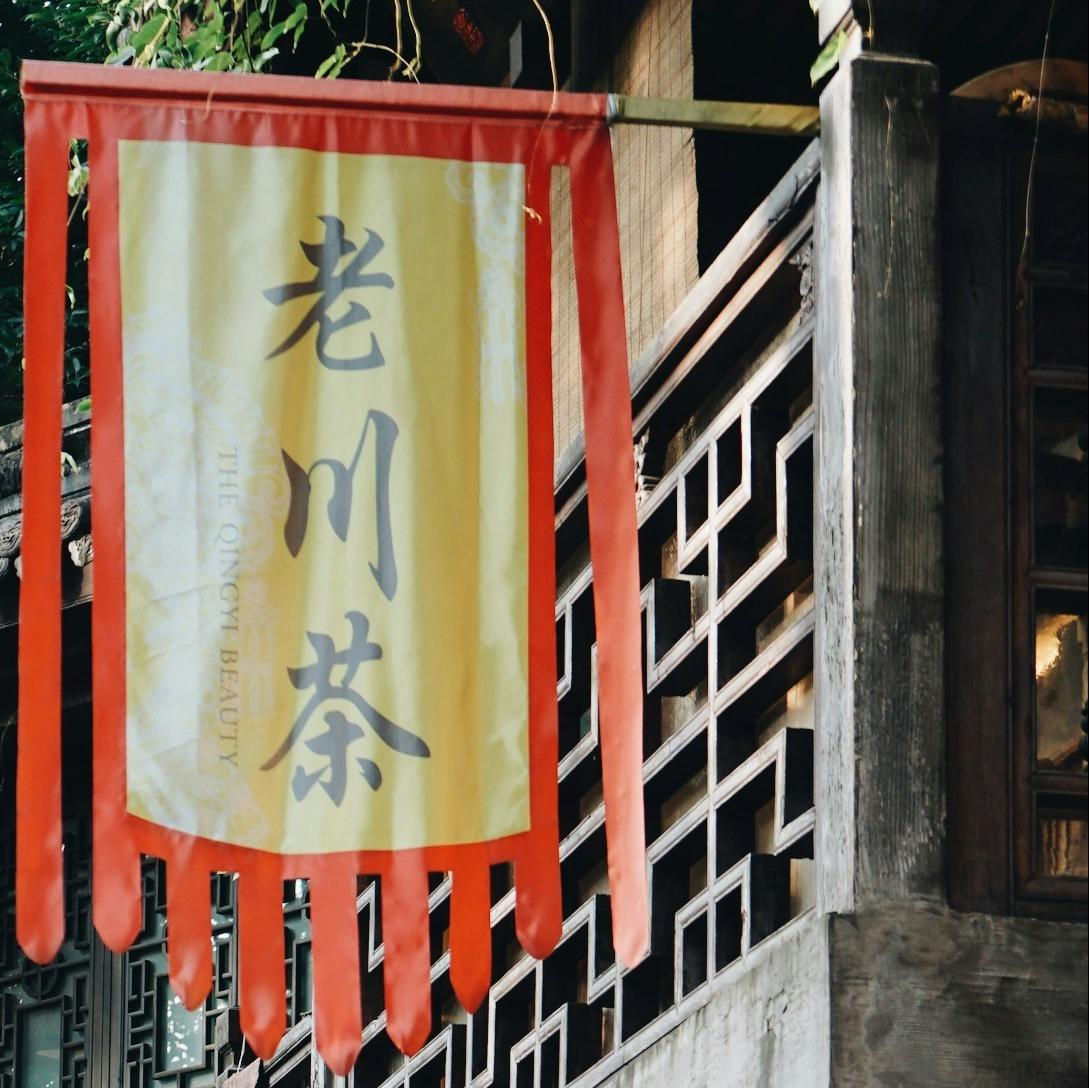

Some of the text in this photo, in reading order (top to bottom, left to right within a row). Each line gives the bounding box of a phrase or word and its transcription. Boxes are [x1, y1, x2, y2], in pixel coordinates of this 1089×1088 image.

[214, 446, 240, 768] THE QINGYI BEAUTY
[260, 215, 431, 808] 老川茶
